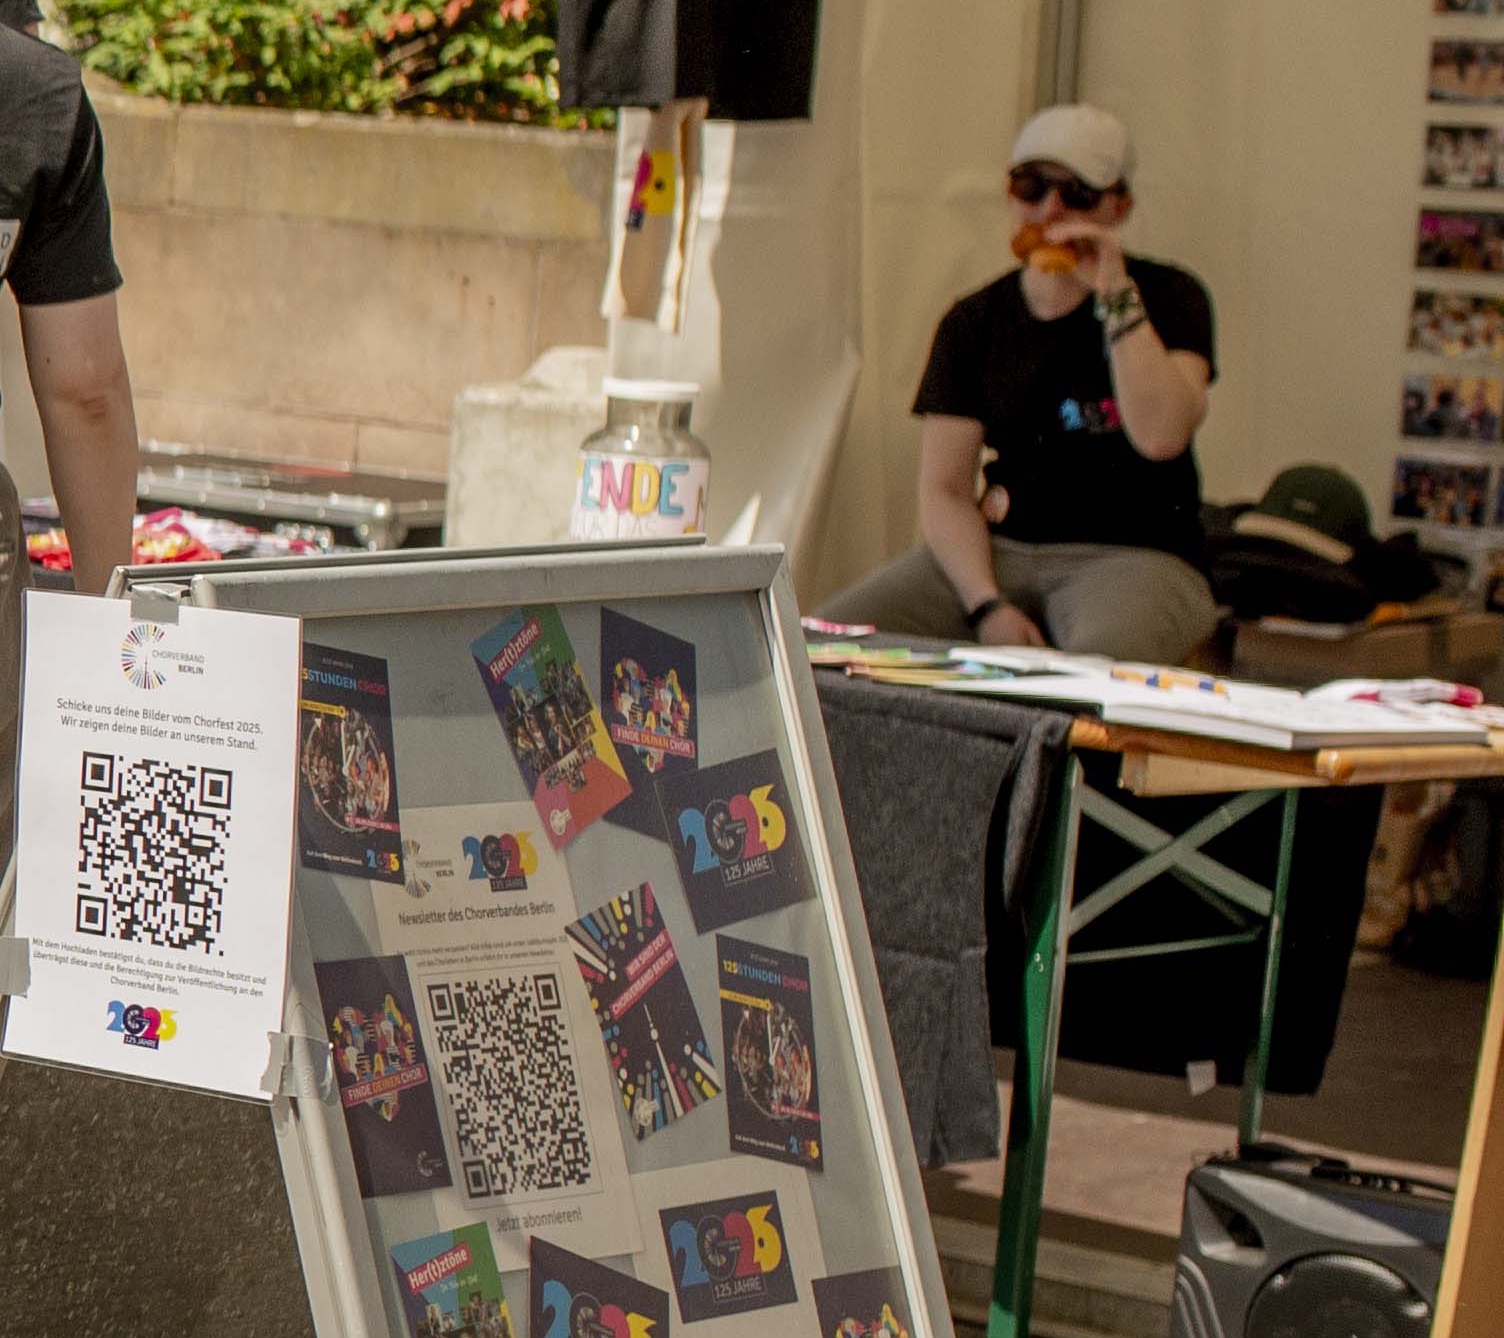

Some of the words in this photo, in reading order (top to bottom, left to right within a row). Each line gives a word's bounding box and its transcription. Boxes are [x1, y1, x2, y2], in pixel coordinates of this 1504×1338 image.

[577, 456, 689, 518] ENDE
[152, 649, 205, 664] CHORVERBAND
[490, 622, 539, 678] Her(t)ztöne
[178, 664, 204, 675] BERLIN
[57, 698, 92, 712] Schicke
[95, 704, 111, 715] uns
[114, 706, 139, 719] deine
[142, 709, 169, 722] Bilder
[172, 715, 191, 726] vom
[194, 715, 234, 731] Chorfest
[237, 721, 263, 734] 2025.
[61, 715, 76, 727] Wir
[79, 717, 109, 733] zeigen
[112, 721, 138, 735] deine
[140, 724, 168, 738] Bilder
[170, 730, 181, 741] an
[184, 732, 224, 746] unserem
[227, 736, 257, 751] Stand.
[617, 727, 640, 743] FINDE
[641, 731, 669, 748] DEINEN
[669, 738, 692, 752] CHOR
[678, 783, 786, 874] 2025
[462, 831, 538, 880] 2025
[725, 864, 742, 881] 125
[743, 855, 769, 876] JAHRE
[399, 909, 446, 925] Newsletter
[448, 907, 464, 922] des
[465, 903, 528, 921] Chorverbandes
[529, 901, 556, 915] Berlin
[106, 1000, 177, 1041] 2025
[349, 1083, 372, 1101] FINDE
[401, 1067, 423, 1082] CHOR
[496, 1217, 521, 1233] Jetzt
[523, 1206, 583, 1229] abonnieren!
[670, 1204, 782, 1286] 2025
[408, 1247, 468, 1289] Her(t)ztöne
[714, 1285, 731, 1299] 125
[733, 1276, 762, 1295] JAHRE
